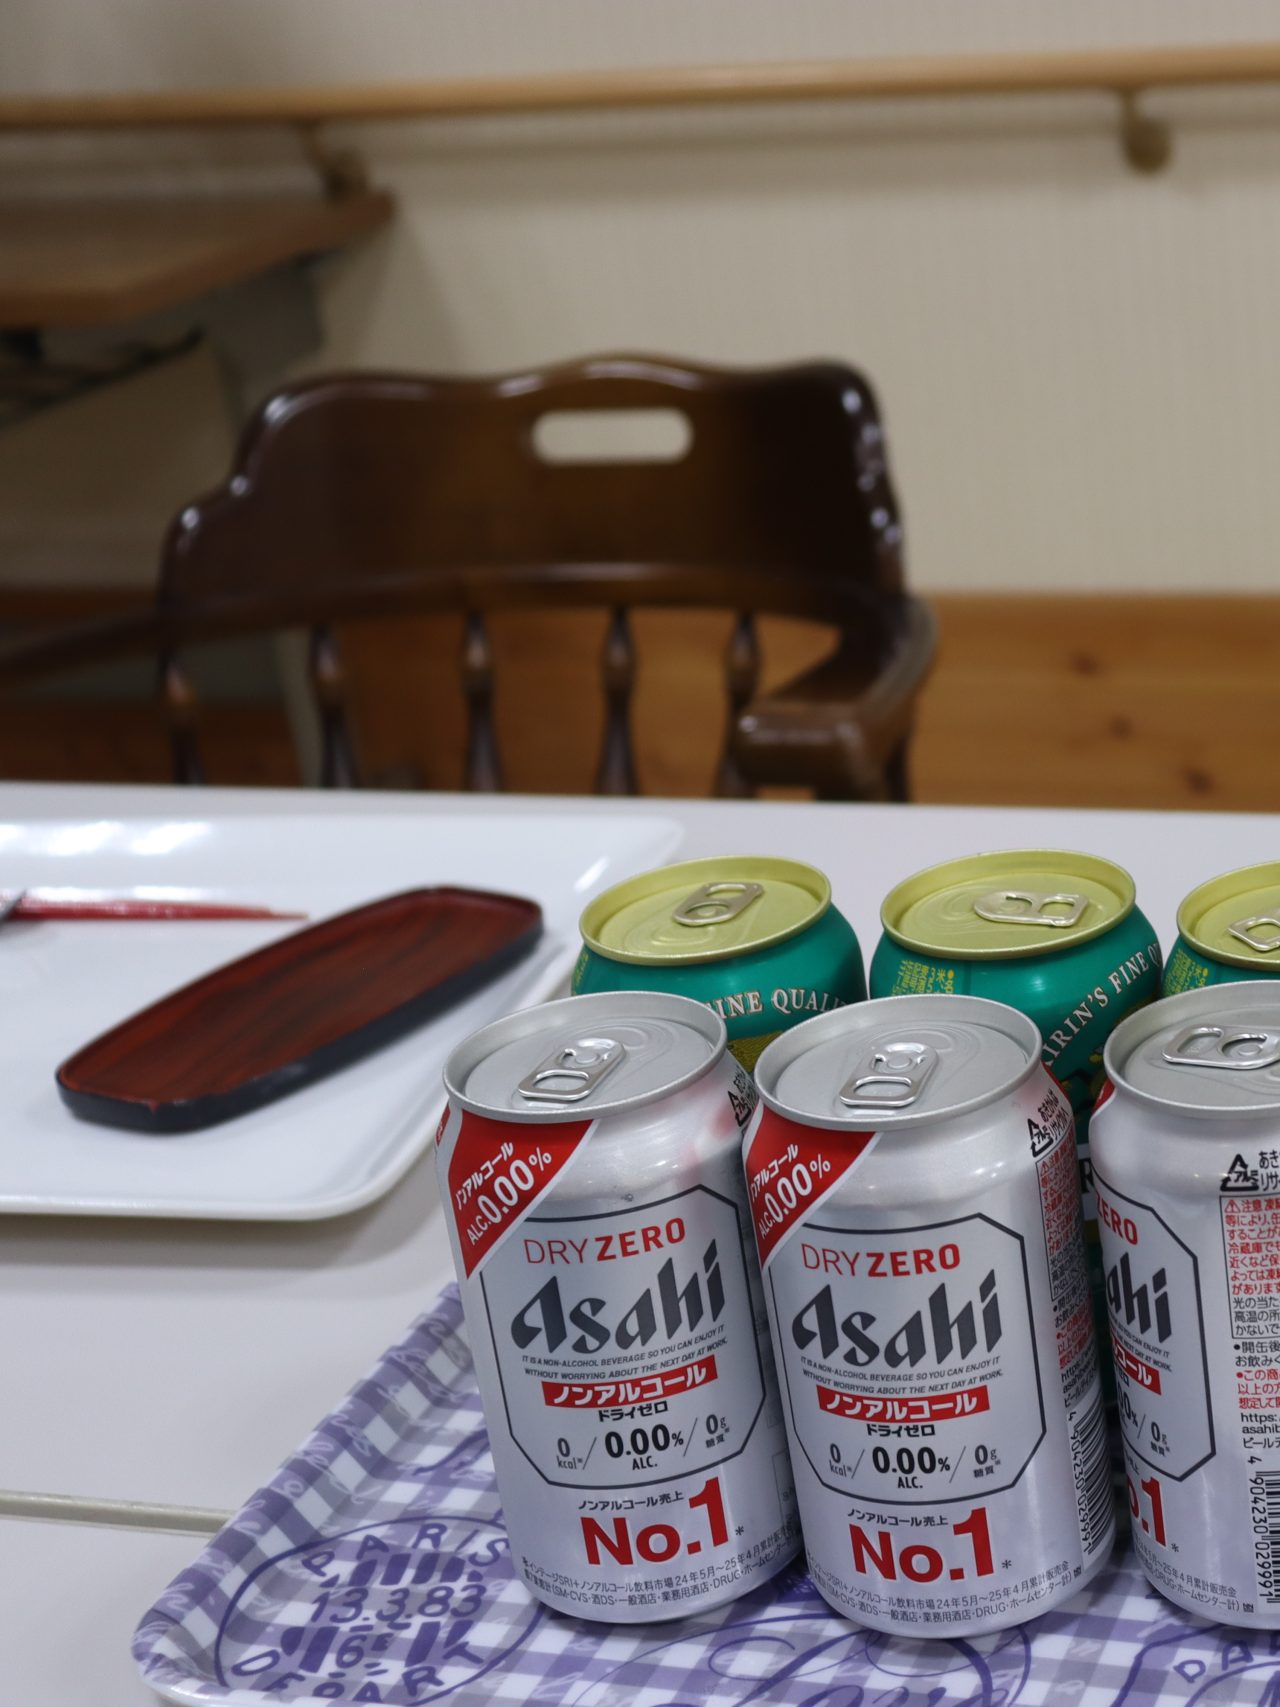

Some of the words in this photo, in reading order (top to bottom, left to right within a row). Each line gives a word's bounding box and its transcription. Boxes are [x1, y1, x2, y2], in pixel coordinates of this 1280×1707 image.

[1108, 951, 1150, 995] FINE
[456, 1142, 514, 1210] ノンアルコール
[524, 1238, 588, 1264] DRY
[595, 1217, 686, 1262] ZERO
[801, 1243, 860, 1277] DRY
[866, 1243, 961, 1278] ZERO
[511, 1238, 725, 1354] Asahi
[792, 1268, 1003, 1368] Asahi
[543, 1358, 599, 1368] NON-ALCOHOL
[601, 1352, 647, 1367] BEVERAGE
[648, 1349, 660, 1359] SO
[661, 1345, 677, 1355] YOU
[677, 1340, 693, 1350] CAN
[695, 1328, 719, 1345] ENJOY
[717, 1324, 725, 1335] IT
[524, 1368, 559, 1379] WITHOUT
[561, 1371, 606, 1380] WORRYING
[609, 1367, 640, 1379] ABOUT
[641, 1363, 658, 1373] THE
[660, 1356, 681, 1369] NEXT
[681, 1351, 697, 1362] DAY
[697, 1346, 706, 1356] AT
[819, 1363, 868, 1381] NON-ALCOHOL
[870, 1373, 914, 1382] BEVERAGE
[916, 1372, 928, 1381] SO
[928, 1370, 946, 1380] YOU
[947, 1367, 964, 1377] CAN
[965, 1359, 991, 1373] ENJOY
[992, 1356, 1001, 1366] IT
[553, 1364, 707, 1407] ノンアルコール
[802, 1368, 832, 1386] WITHOUT
[833, 1381, 875, 1394] WORRYING
[876, 1387, 908, 1395] ABOUT
[909, 1385, 926, 1394] THE
[928, 1382, 950, 1393] NEXT
[951, 1380, 967, 1390] DAY
[967, 1376, 978, 1387] AT
[598, 1400, 669, 1422] ドライゼロ
[826, 1392, 977, 1420] ノンアルコール
[604, 1424, 684, 1459] 0.00%
[866, 1423, 936, 1438] ドライゼロ
[557, 1437, 570, 1458] 0
[830, 1443, 841, 1464] 0
[872, 1446, 950, 1475] 0.00%
[1247, 1455, 1263, 1465] 4
[632, 1456, 658, 1471] ALC.
[897, 1476, 923, 1489] ALC.
[578, 1490, 685, 1511] ノンアルコール売上
[1249, 1476, 1269, 1535] 904230
[848, 1508, 949, 1528] ノンアルコール売上
[1255, 1541, 1275, 1598] 029991
